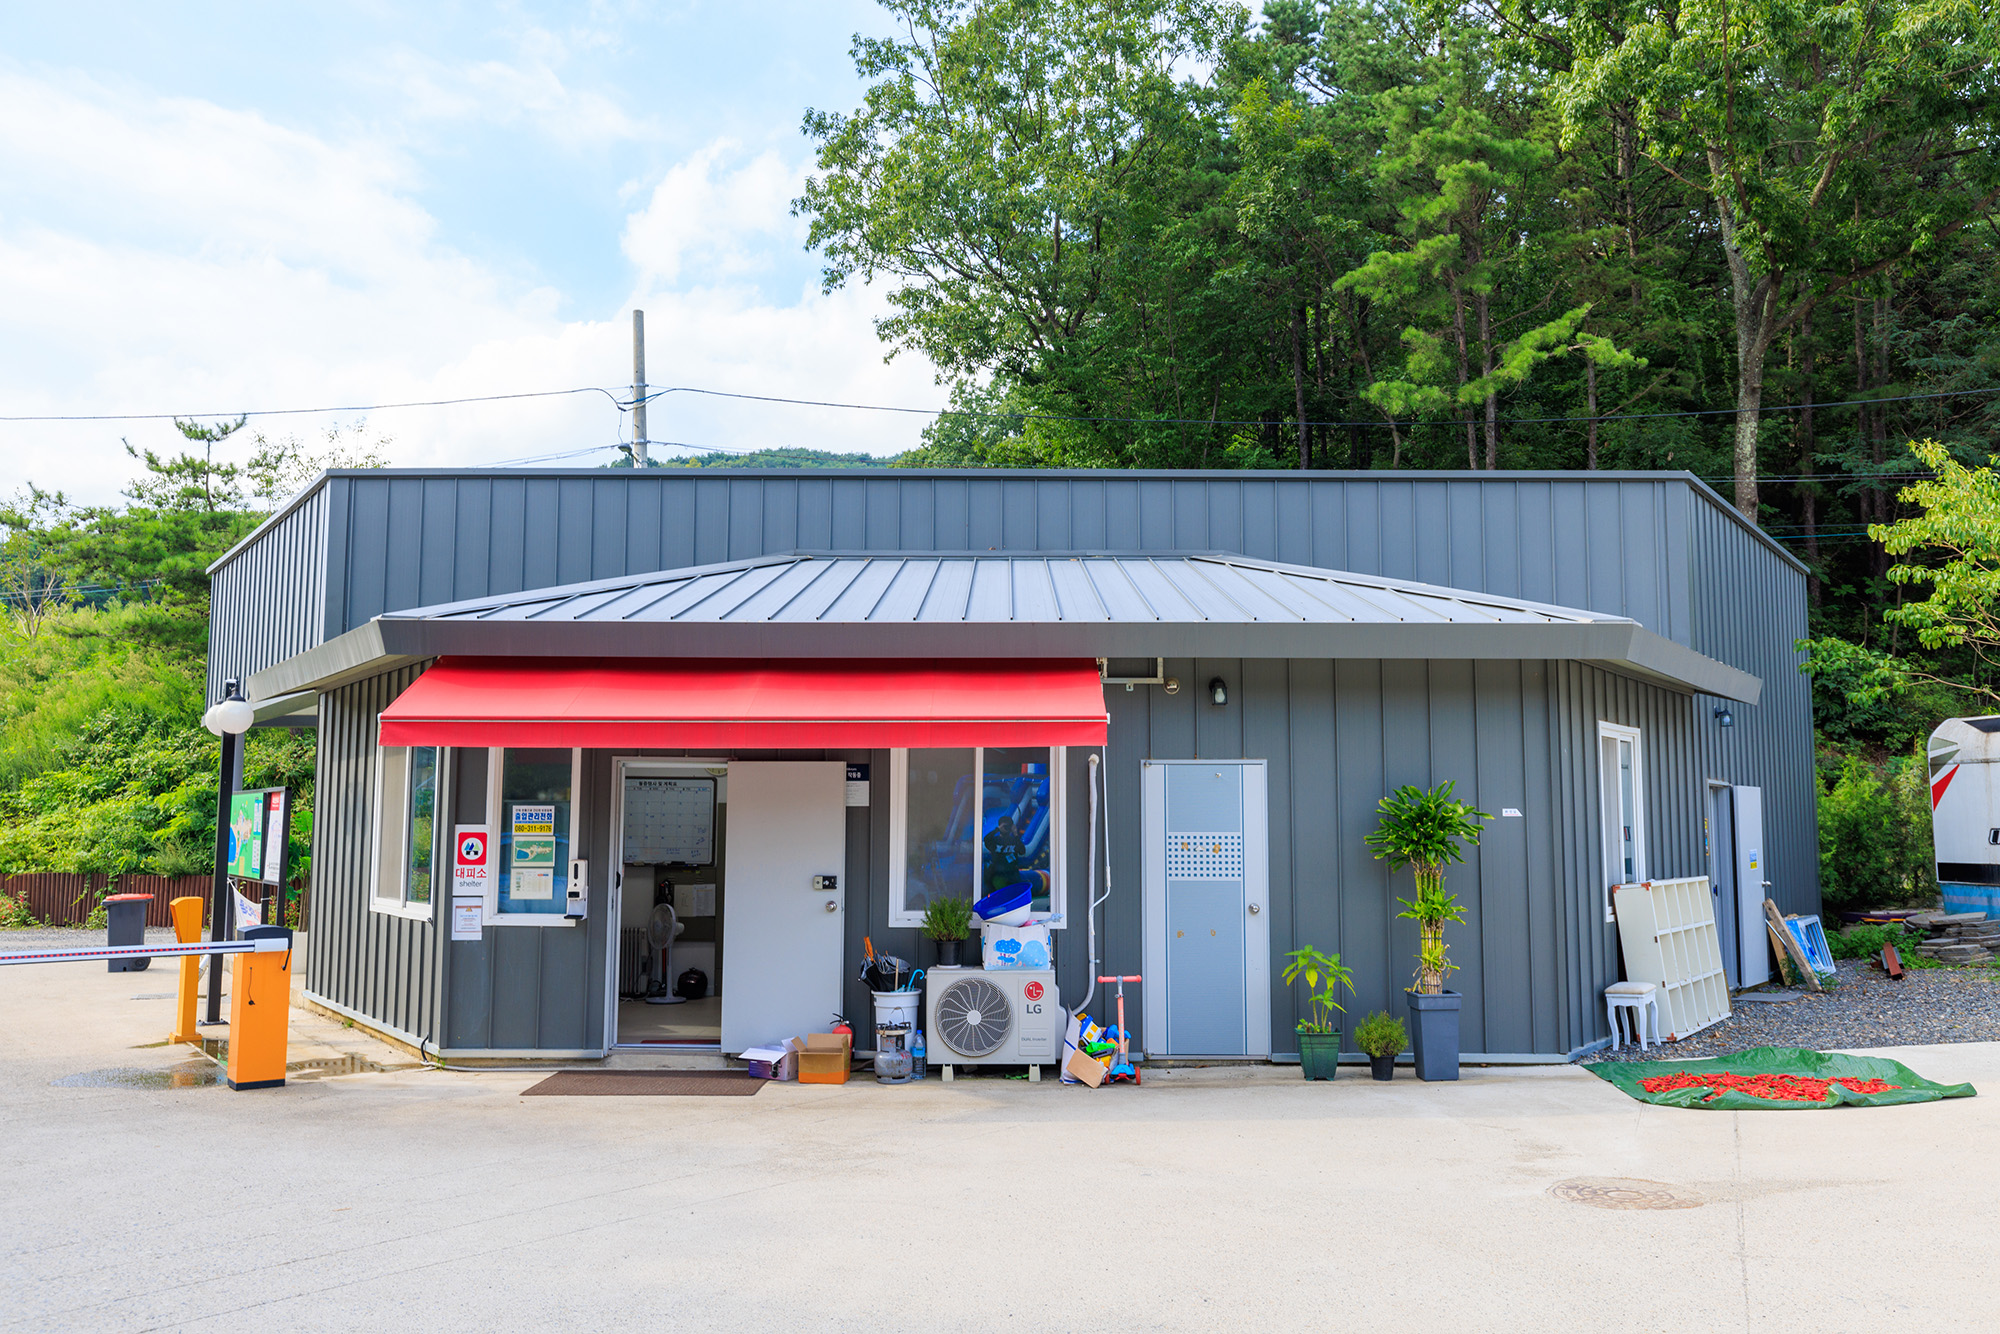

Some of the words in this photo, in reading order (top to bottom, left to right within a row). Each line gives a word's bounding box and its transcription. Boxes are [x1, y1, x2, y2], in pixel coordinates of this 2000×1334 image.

[515, 812, 552, 820] 출입관리전화
[455, 867, 487, 879] 대피소
[1026, 1004, 1042, 1014] LG
